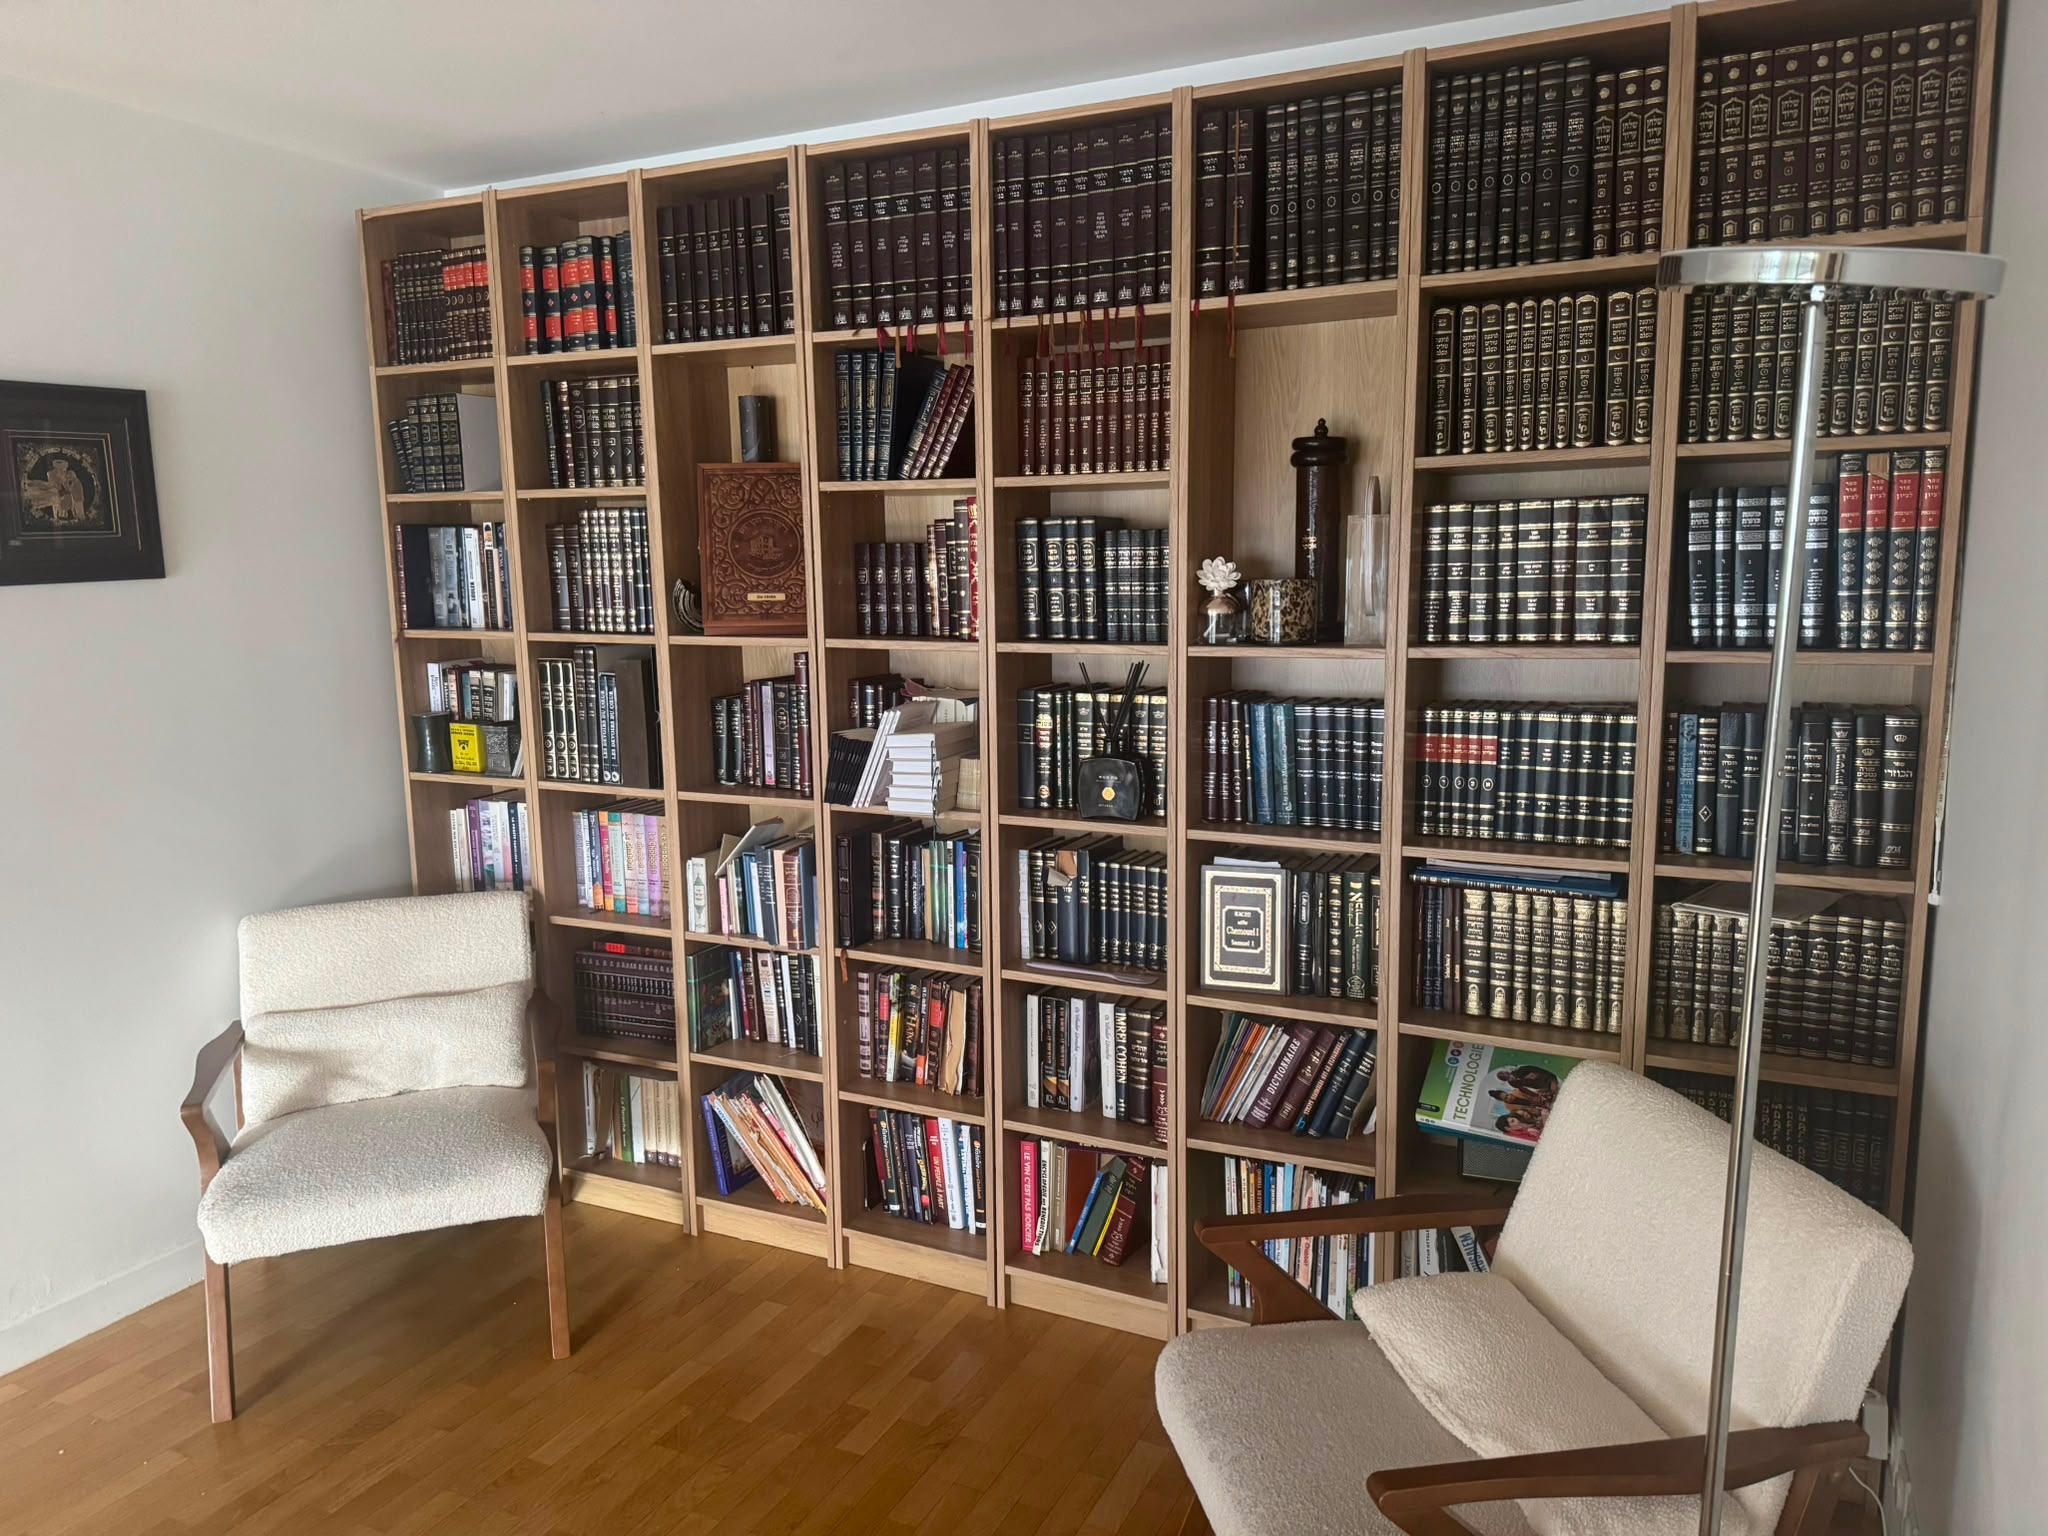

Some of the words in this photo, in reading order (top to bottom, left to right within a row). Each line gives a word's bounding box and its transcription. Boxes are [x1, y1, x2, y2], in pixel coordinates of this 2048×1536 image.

[1923, 77, 1939, 91] שלחן
[1950, 73, 1967, 87] שלחן
[1867, 85, 1884, 98] שלחן
[1894, 81, 1911, 96] שלחן
[1950, 87, 1966, 97] ערוך
[1814, 93, 1830, 107] שלחן
[1839, 89, 1856, 101] שלחן
[1895, 94, 1910, 104] ערוך
[1923, 90, 1939, 100] ערוך
[1752, 101, 1768, 114] שלחן
[1782, 97, 1799, 110] שלחן
[1839, 102, 1854, 112] ערוך
[1867, 98, 1882, 108] ערוך
[1725, 103, 1741, 117] שלחן
[1782, 109, 1798, 119] ערוך
[1814, 106, 1829, 116] ערוך
[1596, 122, 1611, 134] שלחן
[1647, 127, 1661, 137] ערוך
[1596, 135, 1610, 145] ערוך
[1623, 131, 1637, 140] ערוך
[601, 710, 605, 718] DU
[609, 710, 614, 719] DU
[1884, 769, 1912, 778] הכוזרי
[1116, 1012, 1127, 1044] IMREI
[1116, 1046, 1127, 1083] COHEN
[1267, 1038, 1300, 1095] DICTIONNAIRE
[1453, 1044, 1484, 1120] TECHNOLOGIE
[932, 1155, 939, 1164] UN
[1024, 1152, 1030, 1161] LE
[932, 1164, 942, 1187] PEUPLE
[936, 1193, 944, 1209] PART
